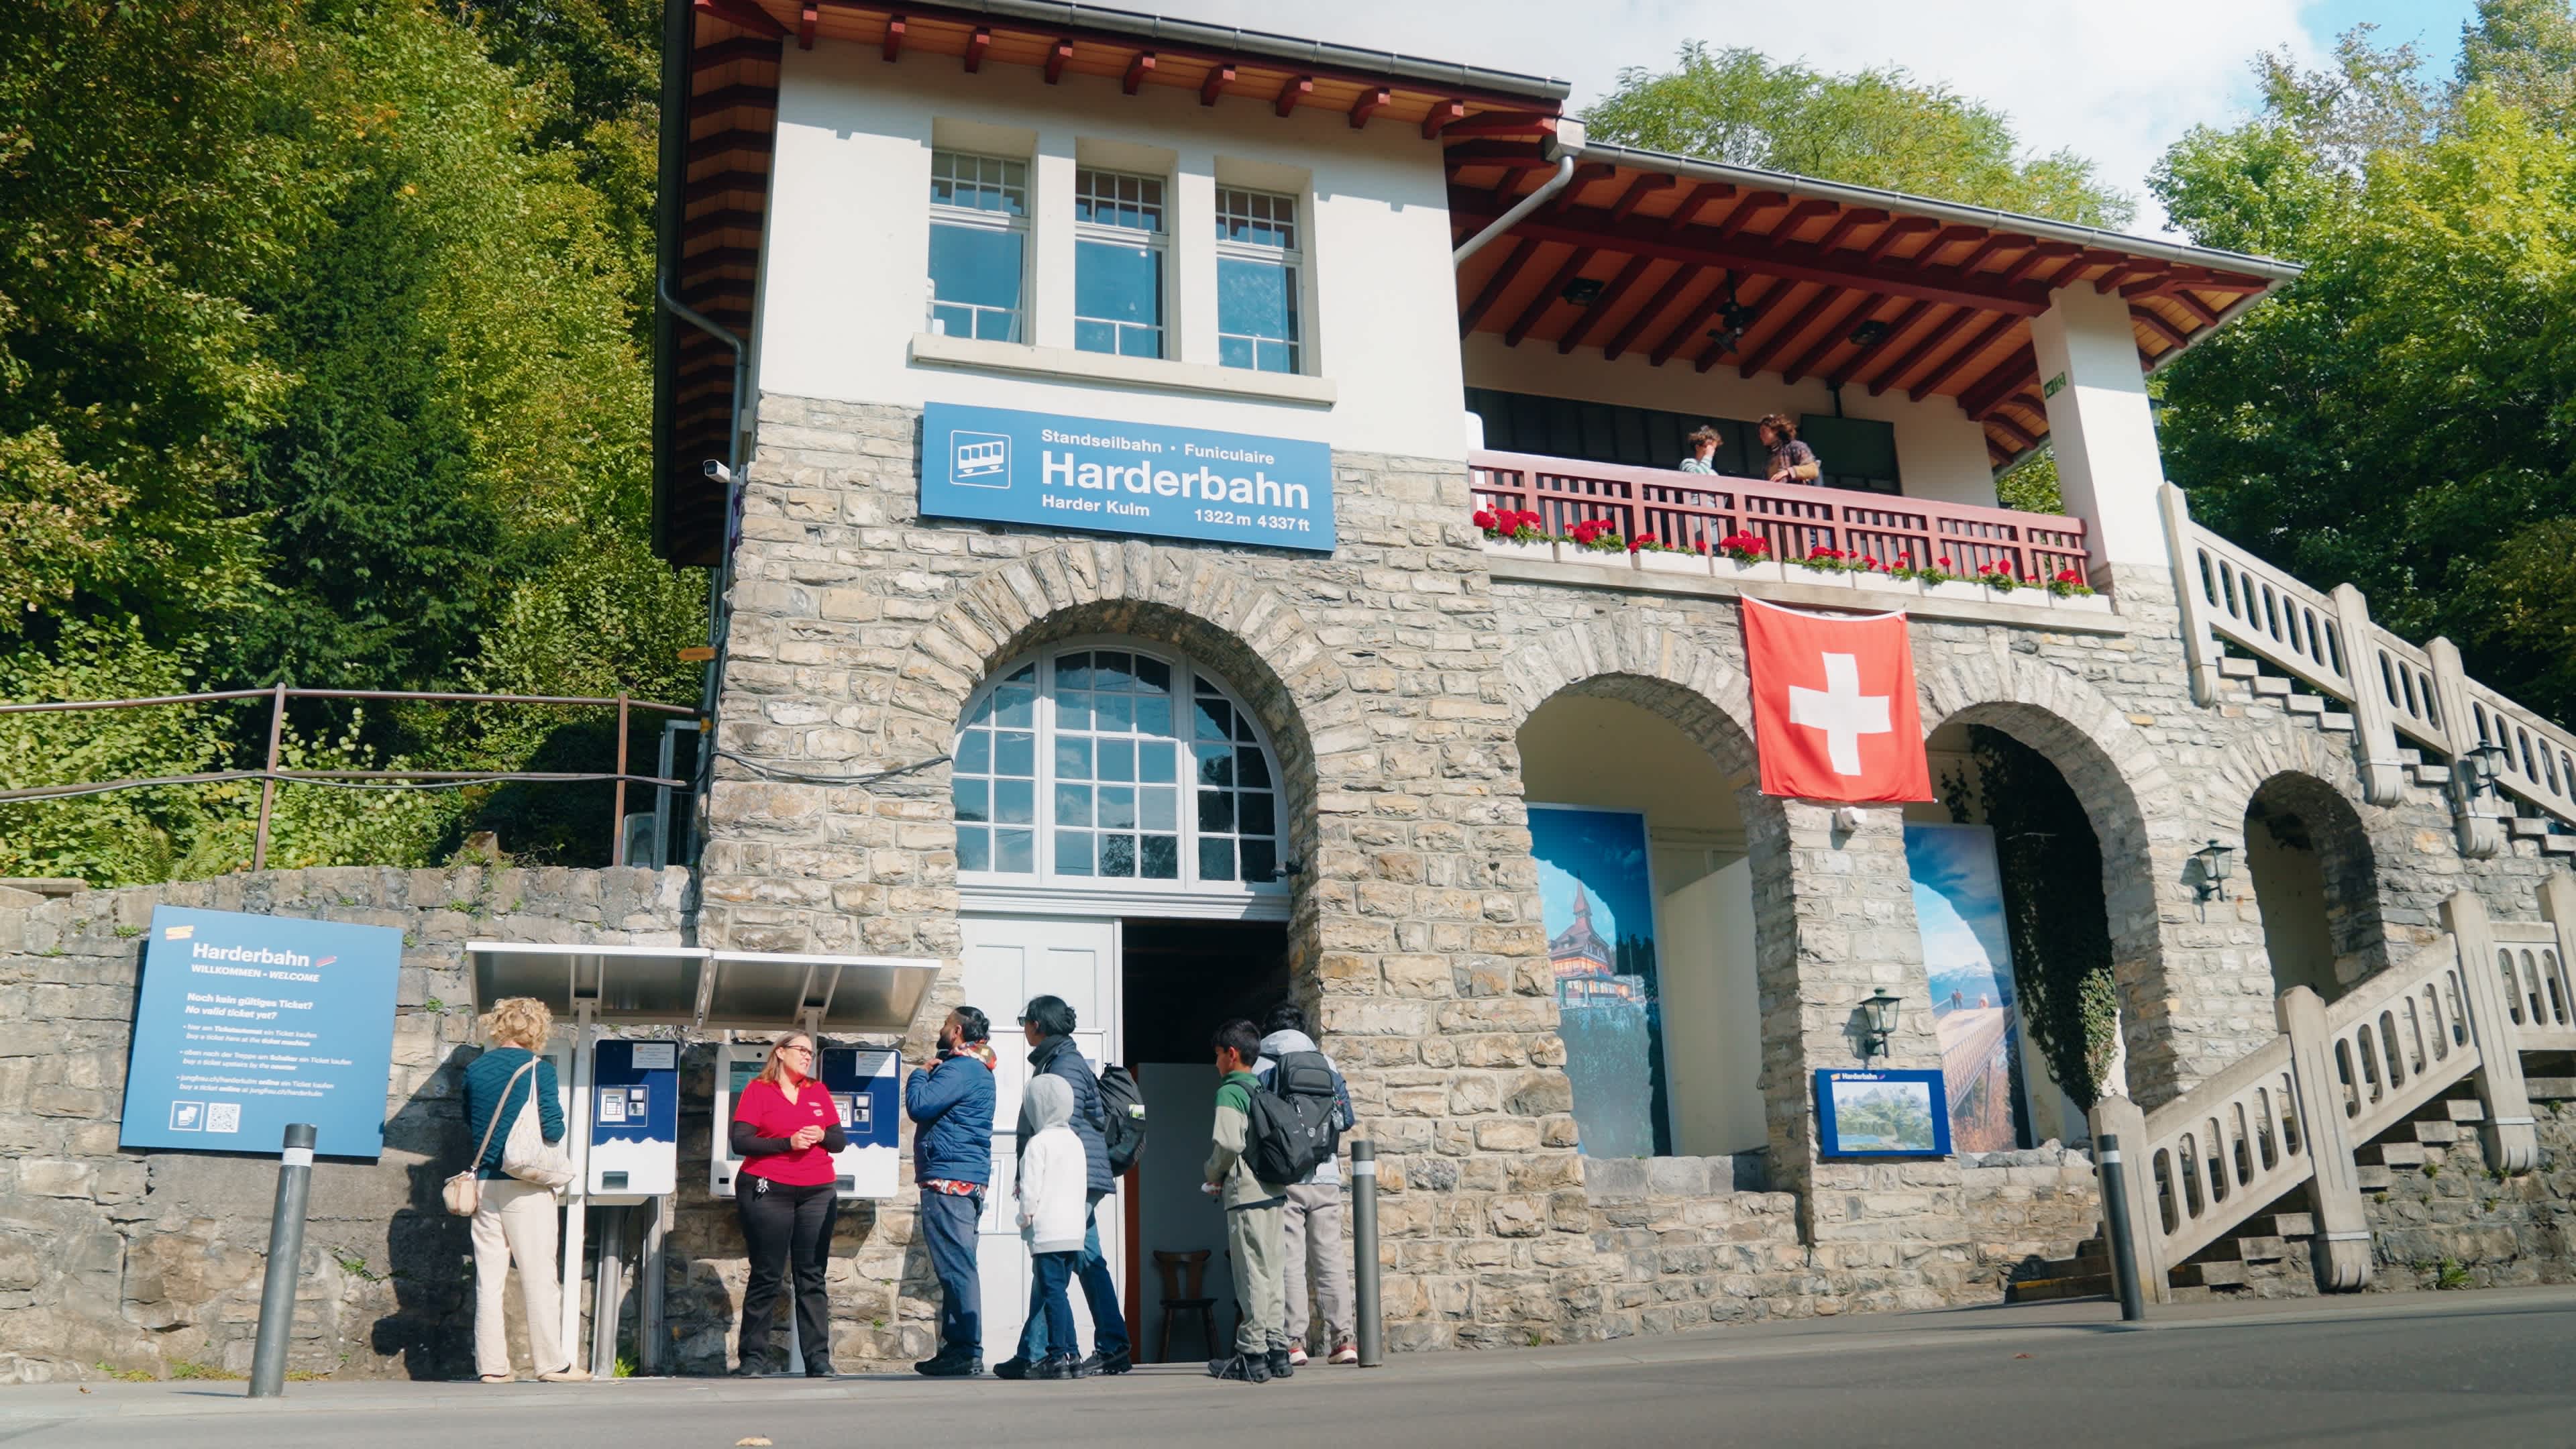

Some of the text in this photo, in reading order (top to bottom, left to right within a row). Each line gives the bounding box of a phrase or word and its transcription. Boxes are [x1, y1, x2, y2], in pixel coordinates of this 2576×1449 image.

[1041, 428, 1162, 453] Standseilbahn
[1185, 443, 1275, 464] Funiculaire
[1042, 450, 1309, 509] Harderbahn
[1042, 494, 1150, 516] Harder Kulm
[193, 943, 309, 967] Harderbahn
[191, 965, 261, 977] WILLKOMMEN
[269, 971, 320, 983] WELCOME
[187, 993, 313, 1010] Noch kein gültiges Ticket?
[185, 1006, 278, 1020] No valid ticket yet?
